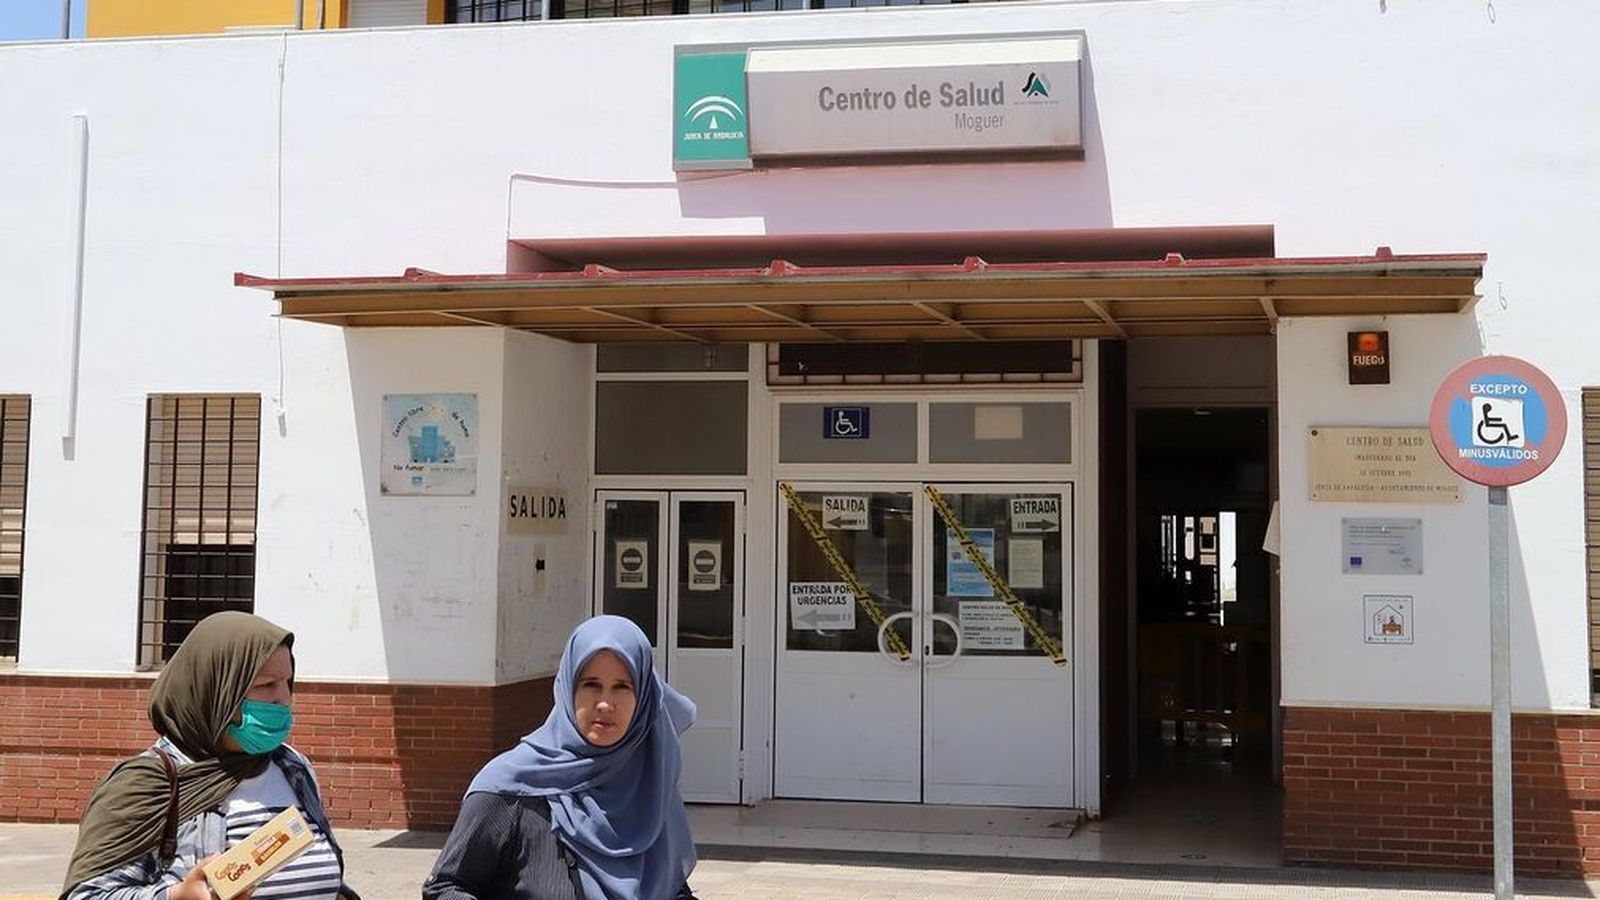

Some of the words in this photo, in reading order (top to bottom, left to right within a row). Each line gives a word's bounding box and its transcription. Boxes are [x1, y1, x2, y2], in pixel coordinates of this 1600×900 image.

[818, 86, 897, 112] Centro
[903, 84, 932, 109] de
[939, 81, 1005, 108] Salud
[954, 112, 1005, 132] Moguer
[1469, 383, 1528, 395] EXCEPTO
[1346, 436, 1379, 447] CENTRO
[1382, 436, 1393, 447] DE
[1397, 436, 1425, 447] SALUD
[1458, 448, 1539, 460] MINUSVÁLIDOS
[509, 495, 567, 519] SALIDA
[825, 499, 866, 511] SALIDA
[1013, 500, 1057, 514] ENTRADA
[792, 585, 832, 595] ENTRADA
[797, 595, 847, 606] URGENCIAS
